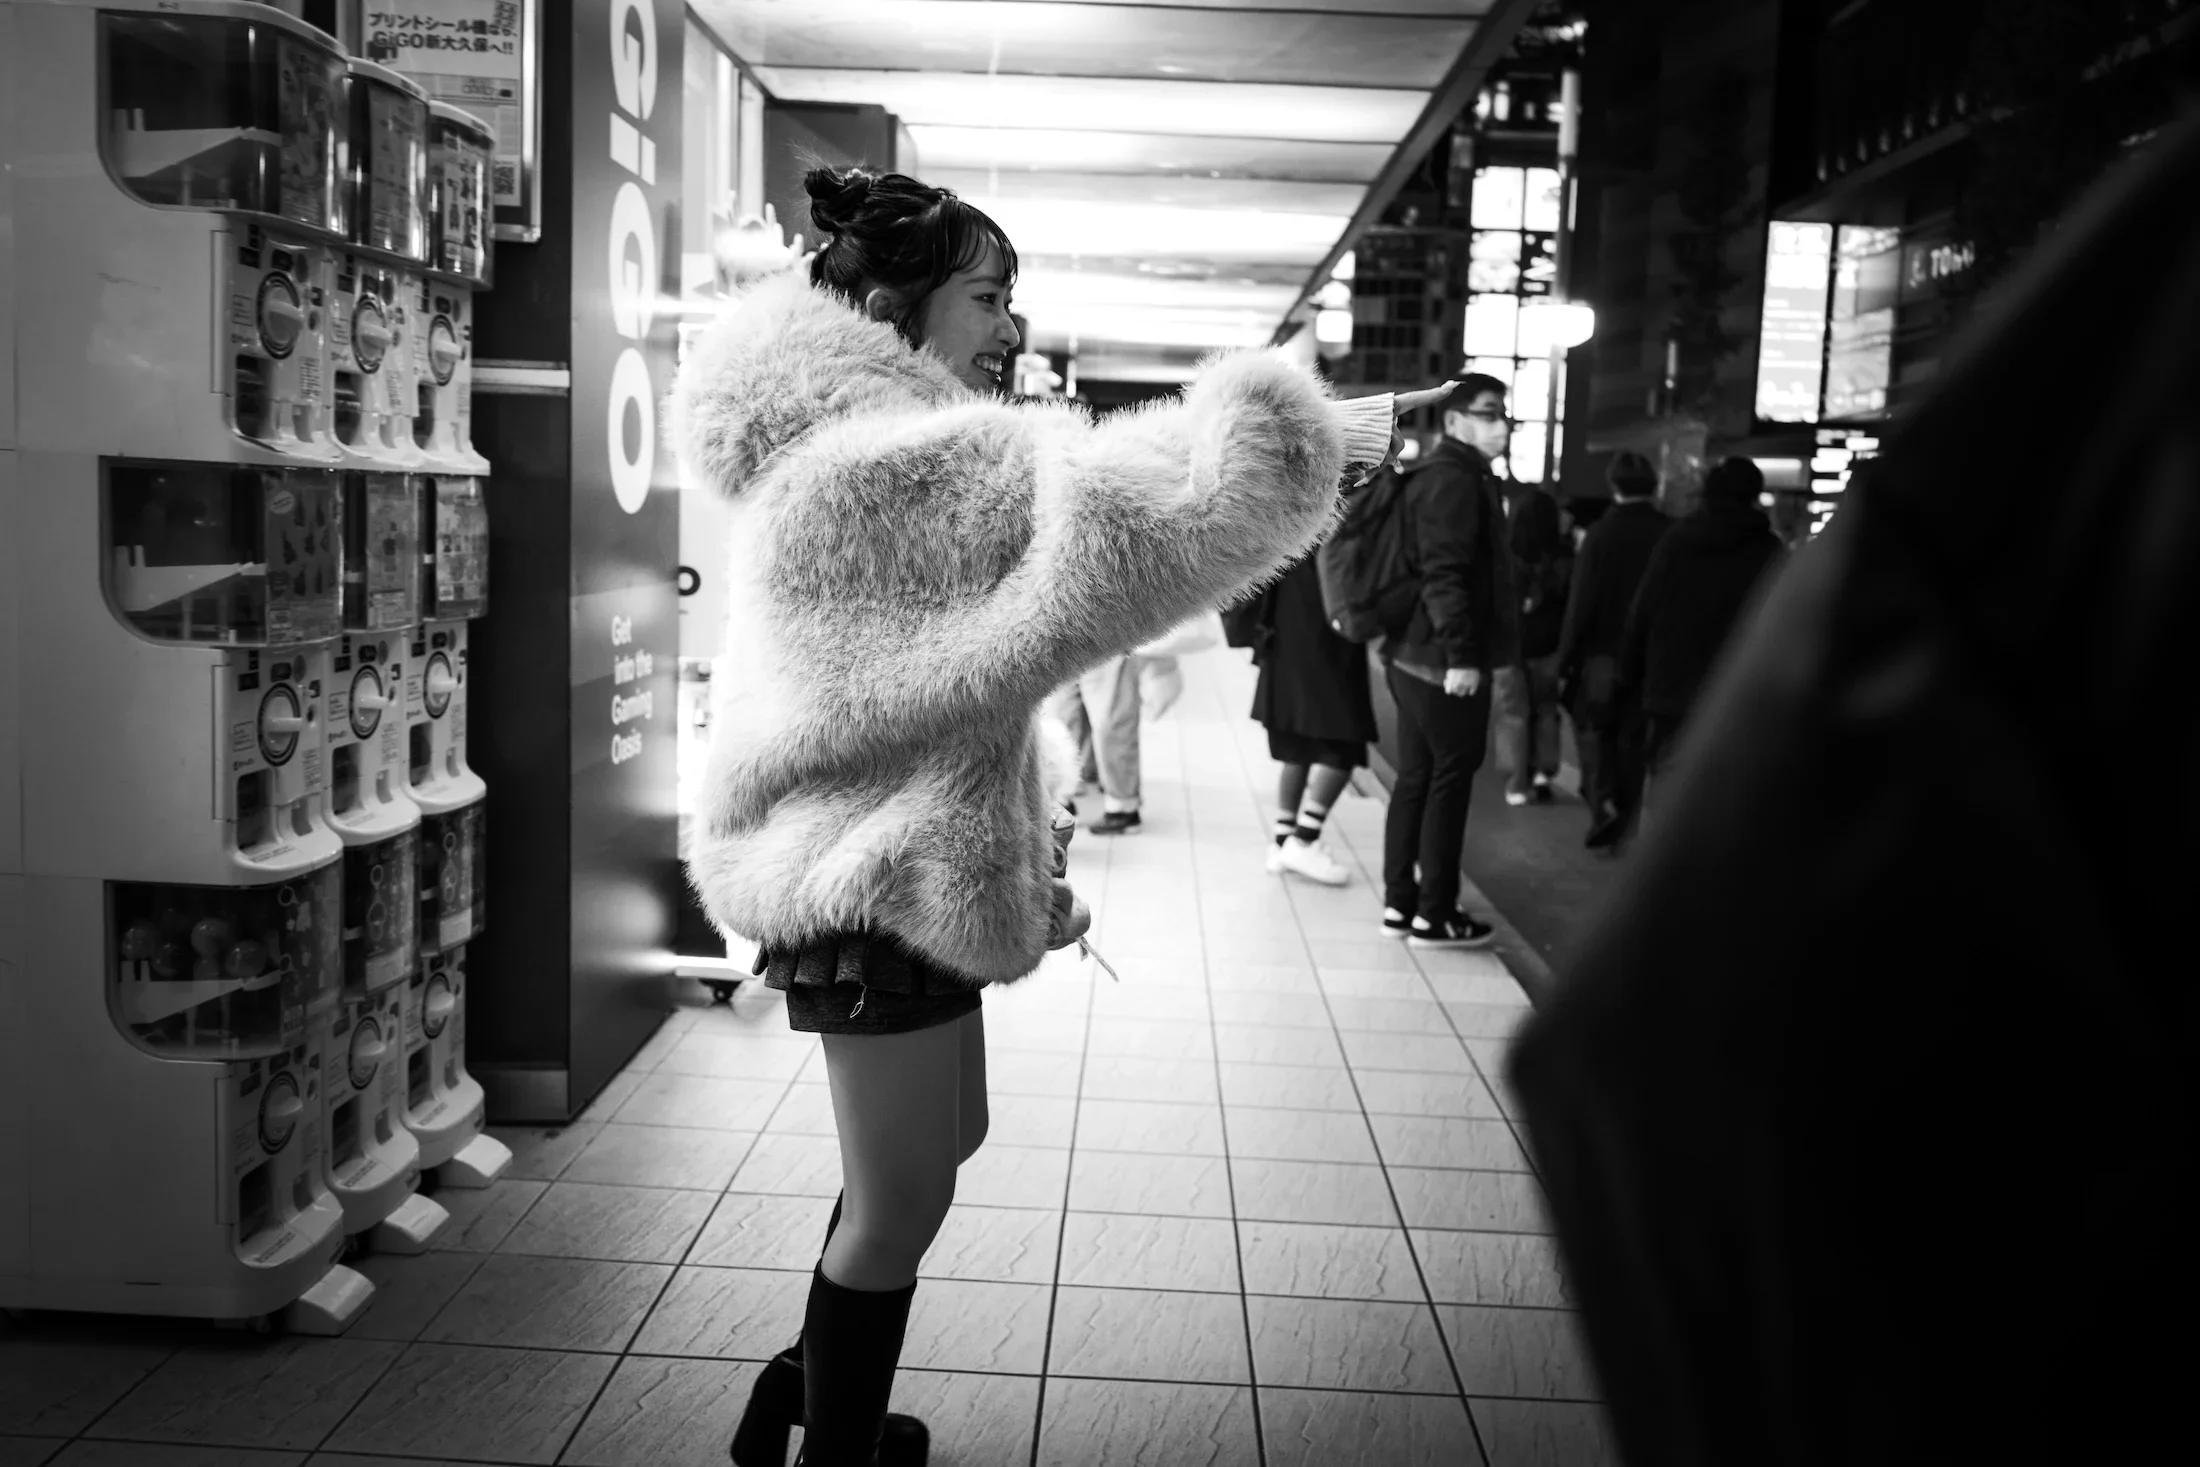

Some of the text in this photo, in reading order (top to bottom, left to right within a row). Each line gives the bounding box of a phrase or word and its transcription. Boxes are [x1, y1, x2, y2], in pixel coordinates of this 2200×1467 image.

[608, 0, 658, 514] GiGO
[612, 615, 632, 646] Get
[615, 649, 653, 685] into the
[612, 688, 653, 725] Gaming
[612, 728, 642, 765] Oasis
